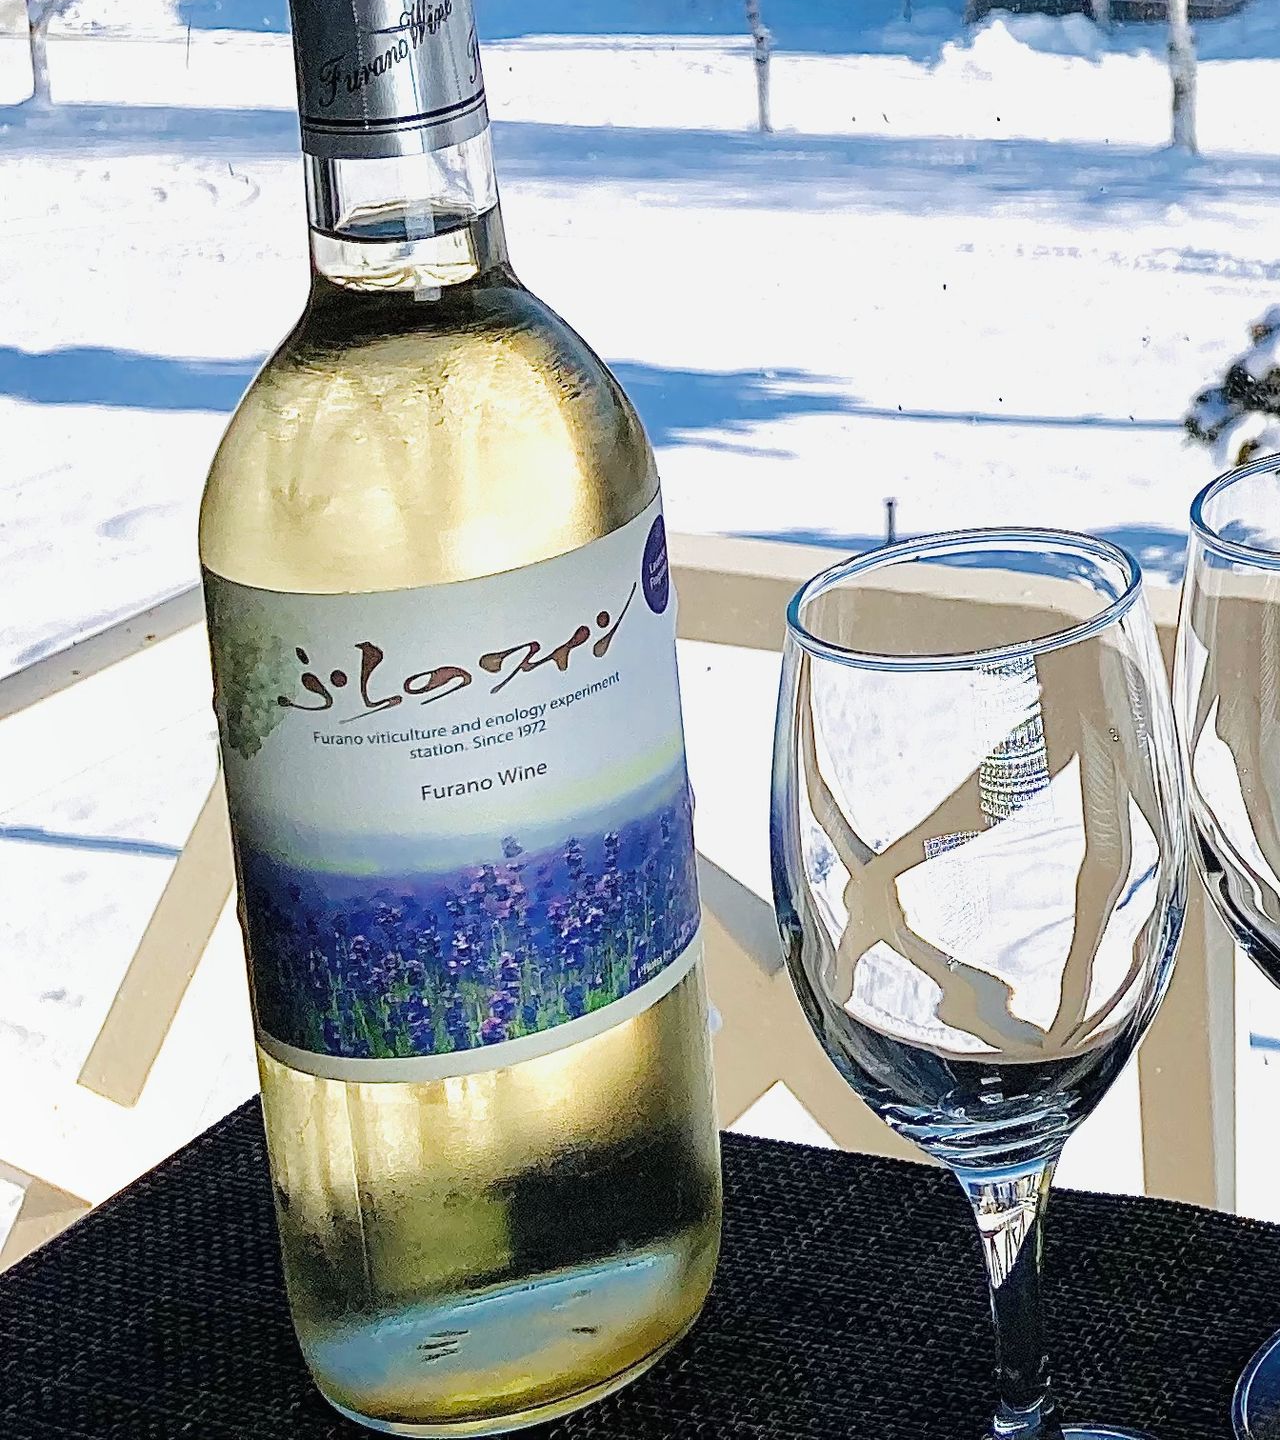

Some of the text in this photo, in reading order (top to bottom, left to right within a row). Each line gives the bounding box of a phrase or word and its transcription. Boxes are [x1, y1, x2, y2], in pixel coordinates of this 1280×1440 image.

[318, 38, 409, 108] Furano
[312, 670, 621, 745] Furano viticulture and enology experiment
[472, 730, 515, 750] Since
[517, 719, 547, 740] 1972
[420, 761, 548, 802] Furano Wine
